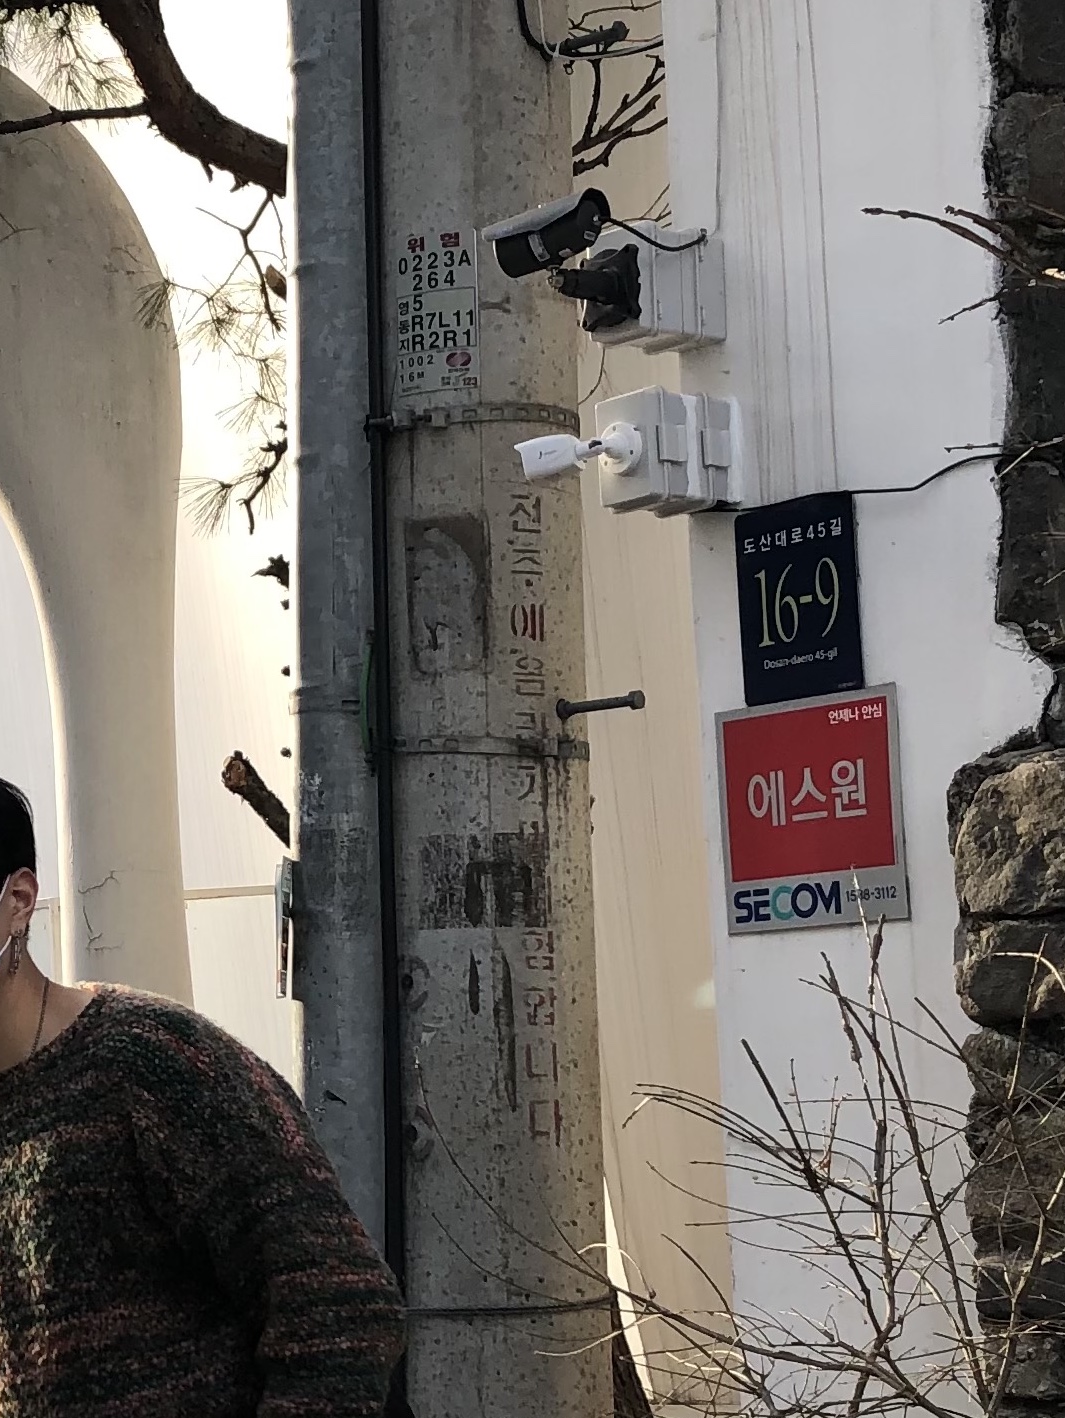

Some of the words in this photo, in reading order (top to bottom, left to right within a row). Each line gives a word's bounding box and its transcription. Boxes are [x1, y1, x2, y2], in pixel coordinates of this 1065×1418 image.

[398, 249, 472, 275] 0223A
[412, 269, 455, 291] 264
[412, 294, 423, 311] 5
[399, 354, 434, 369] 1002
[743, 517, 843, 554] 도산대로45길
[754, 557, 840, 648] 16-9
[828, 707, 860, 725] 언제나
[861, 702, 883, 720] 안심
[747, 758, 867, 827] 에스원
[733, 880, 842, 924] SECOM
